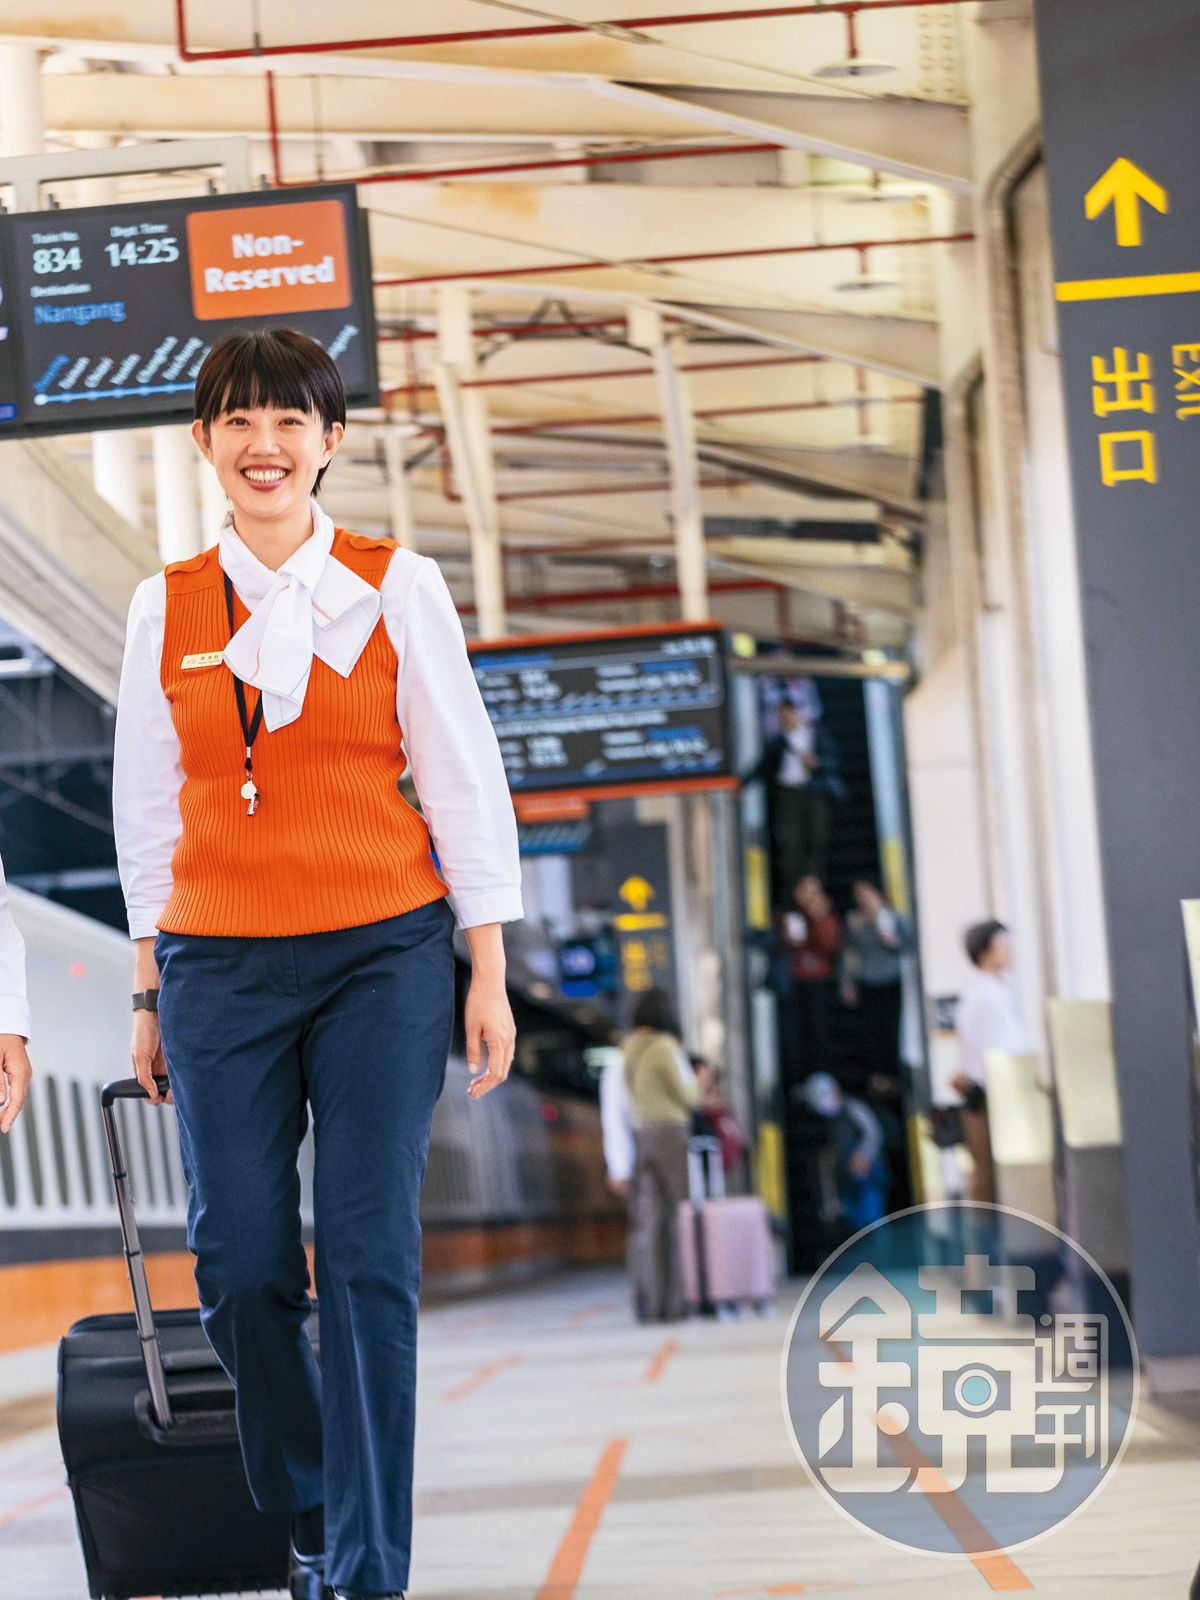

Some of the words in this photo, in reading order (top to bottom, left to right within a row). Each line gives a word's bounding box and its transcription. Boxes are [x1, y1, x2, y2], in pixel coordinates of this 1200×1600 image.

[104, 236, 180, 267] 14:25
[231, 231, 304, 259] Non-
[33, 246, 83, 274] 834
[204, 255, 336, 293] Reserved
[33, 301, 126, 326] Nangang
[1090, 345, 1158, 487] 出口
